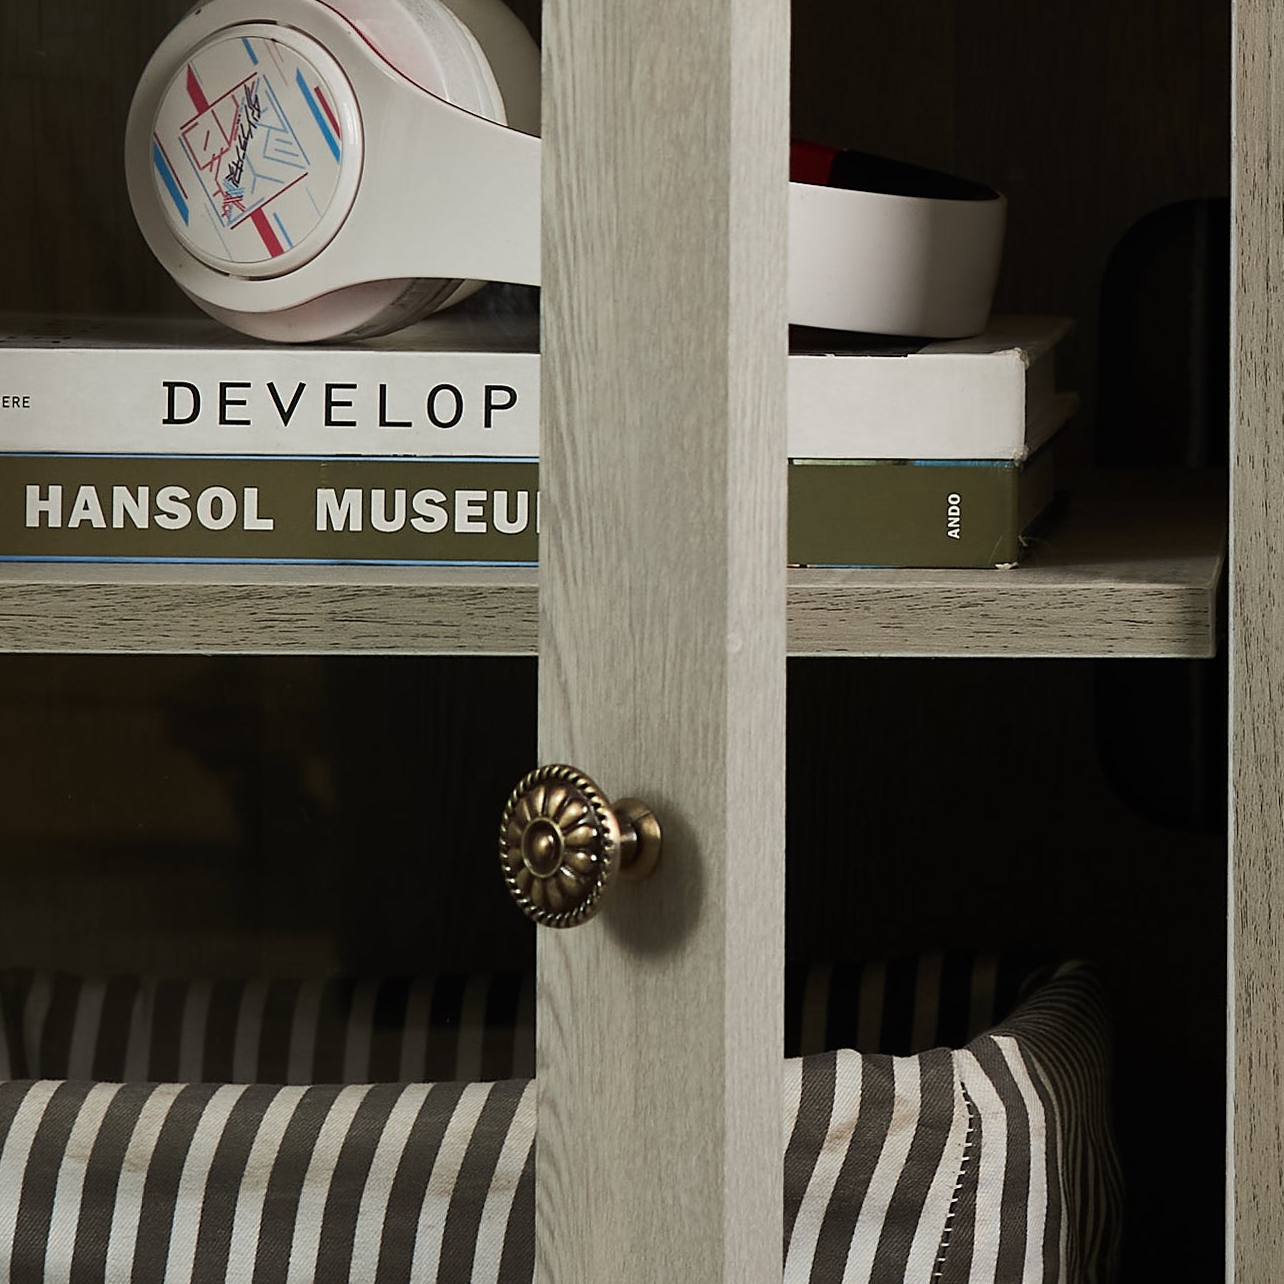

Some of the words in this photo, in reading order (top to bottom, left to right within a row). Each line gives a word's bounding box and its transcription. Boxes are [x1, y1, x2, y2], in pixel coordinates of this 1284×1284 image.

[162, 381, 519, 429] DEVELOP
[24, 484, 275, 532] HANSOL
[315, 488, 540, 534] MUSEU
[947, 493, 961, 539] ANDO
